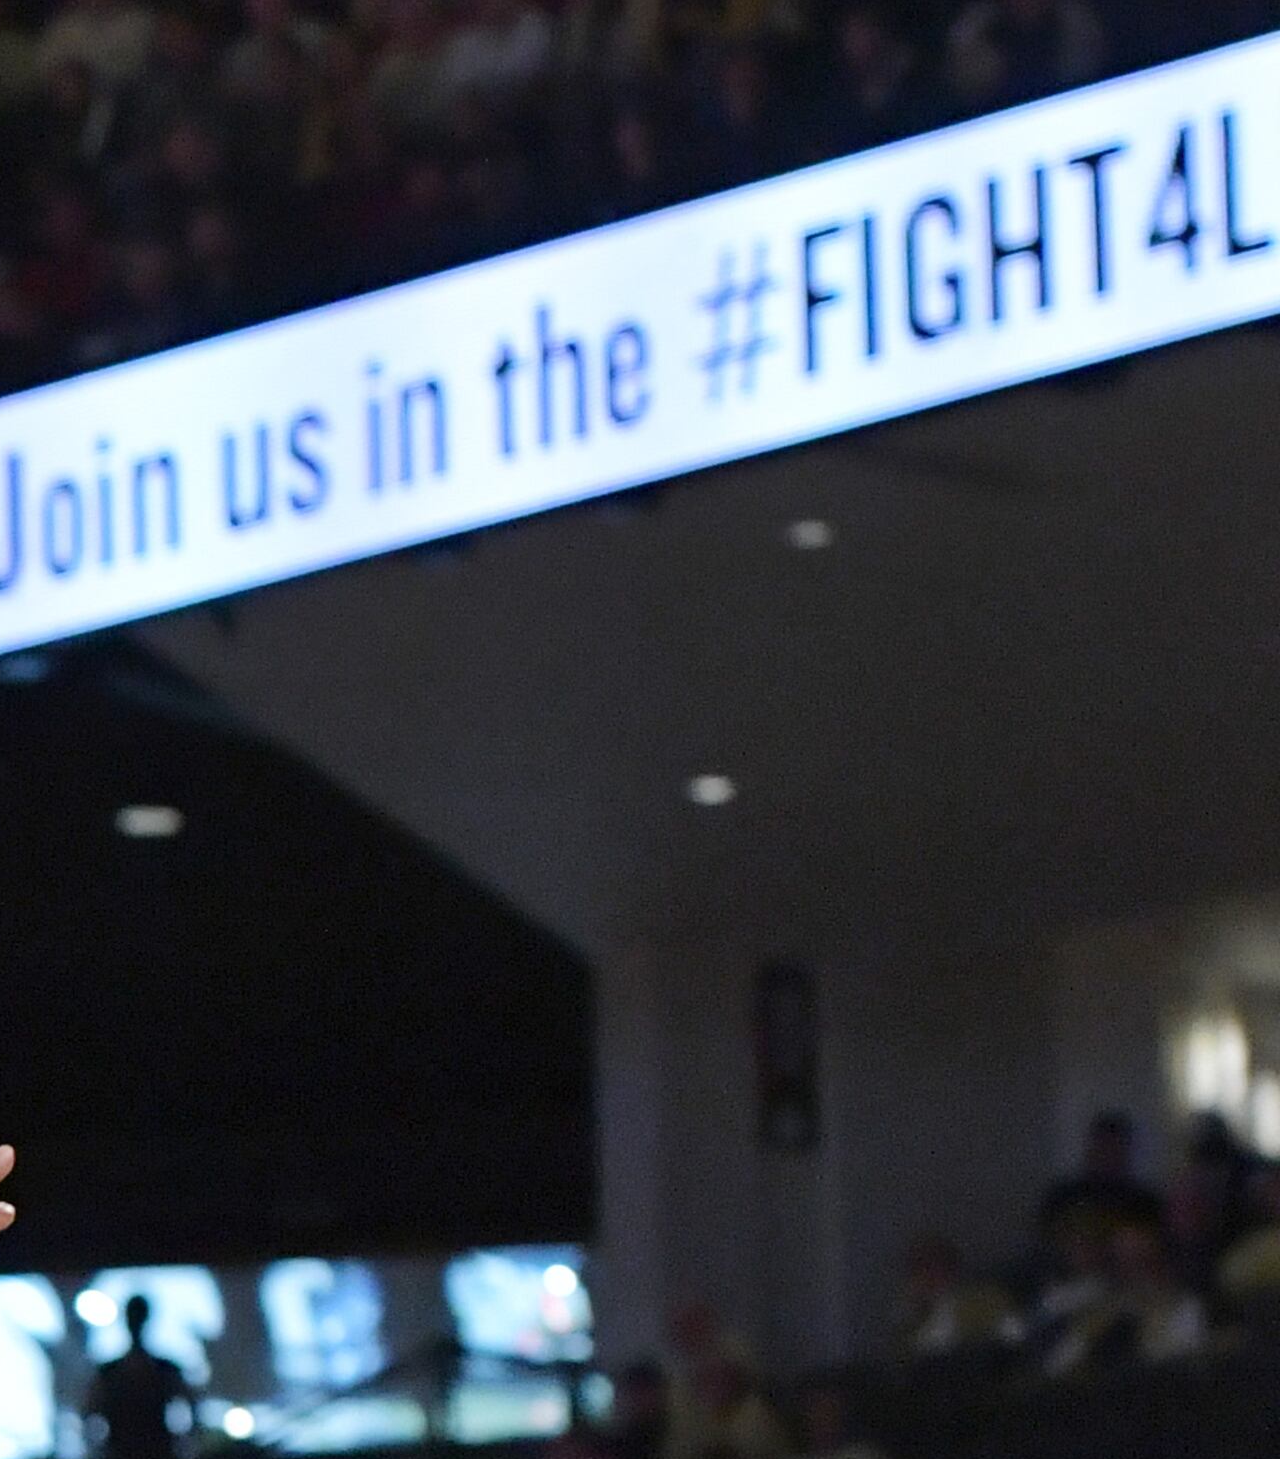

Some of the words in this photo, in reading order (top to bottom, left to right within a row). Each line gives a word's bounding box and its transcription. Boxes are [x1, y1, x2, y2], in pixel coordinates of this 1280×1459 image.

[222, 406, 330, 532] us
[364, 358, 448, 495] in
[492, 301, 652, 459] the
[698, 107, 1273, 402] #FIGHT4L
